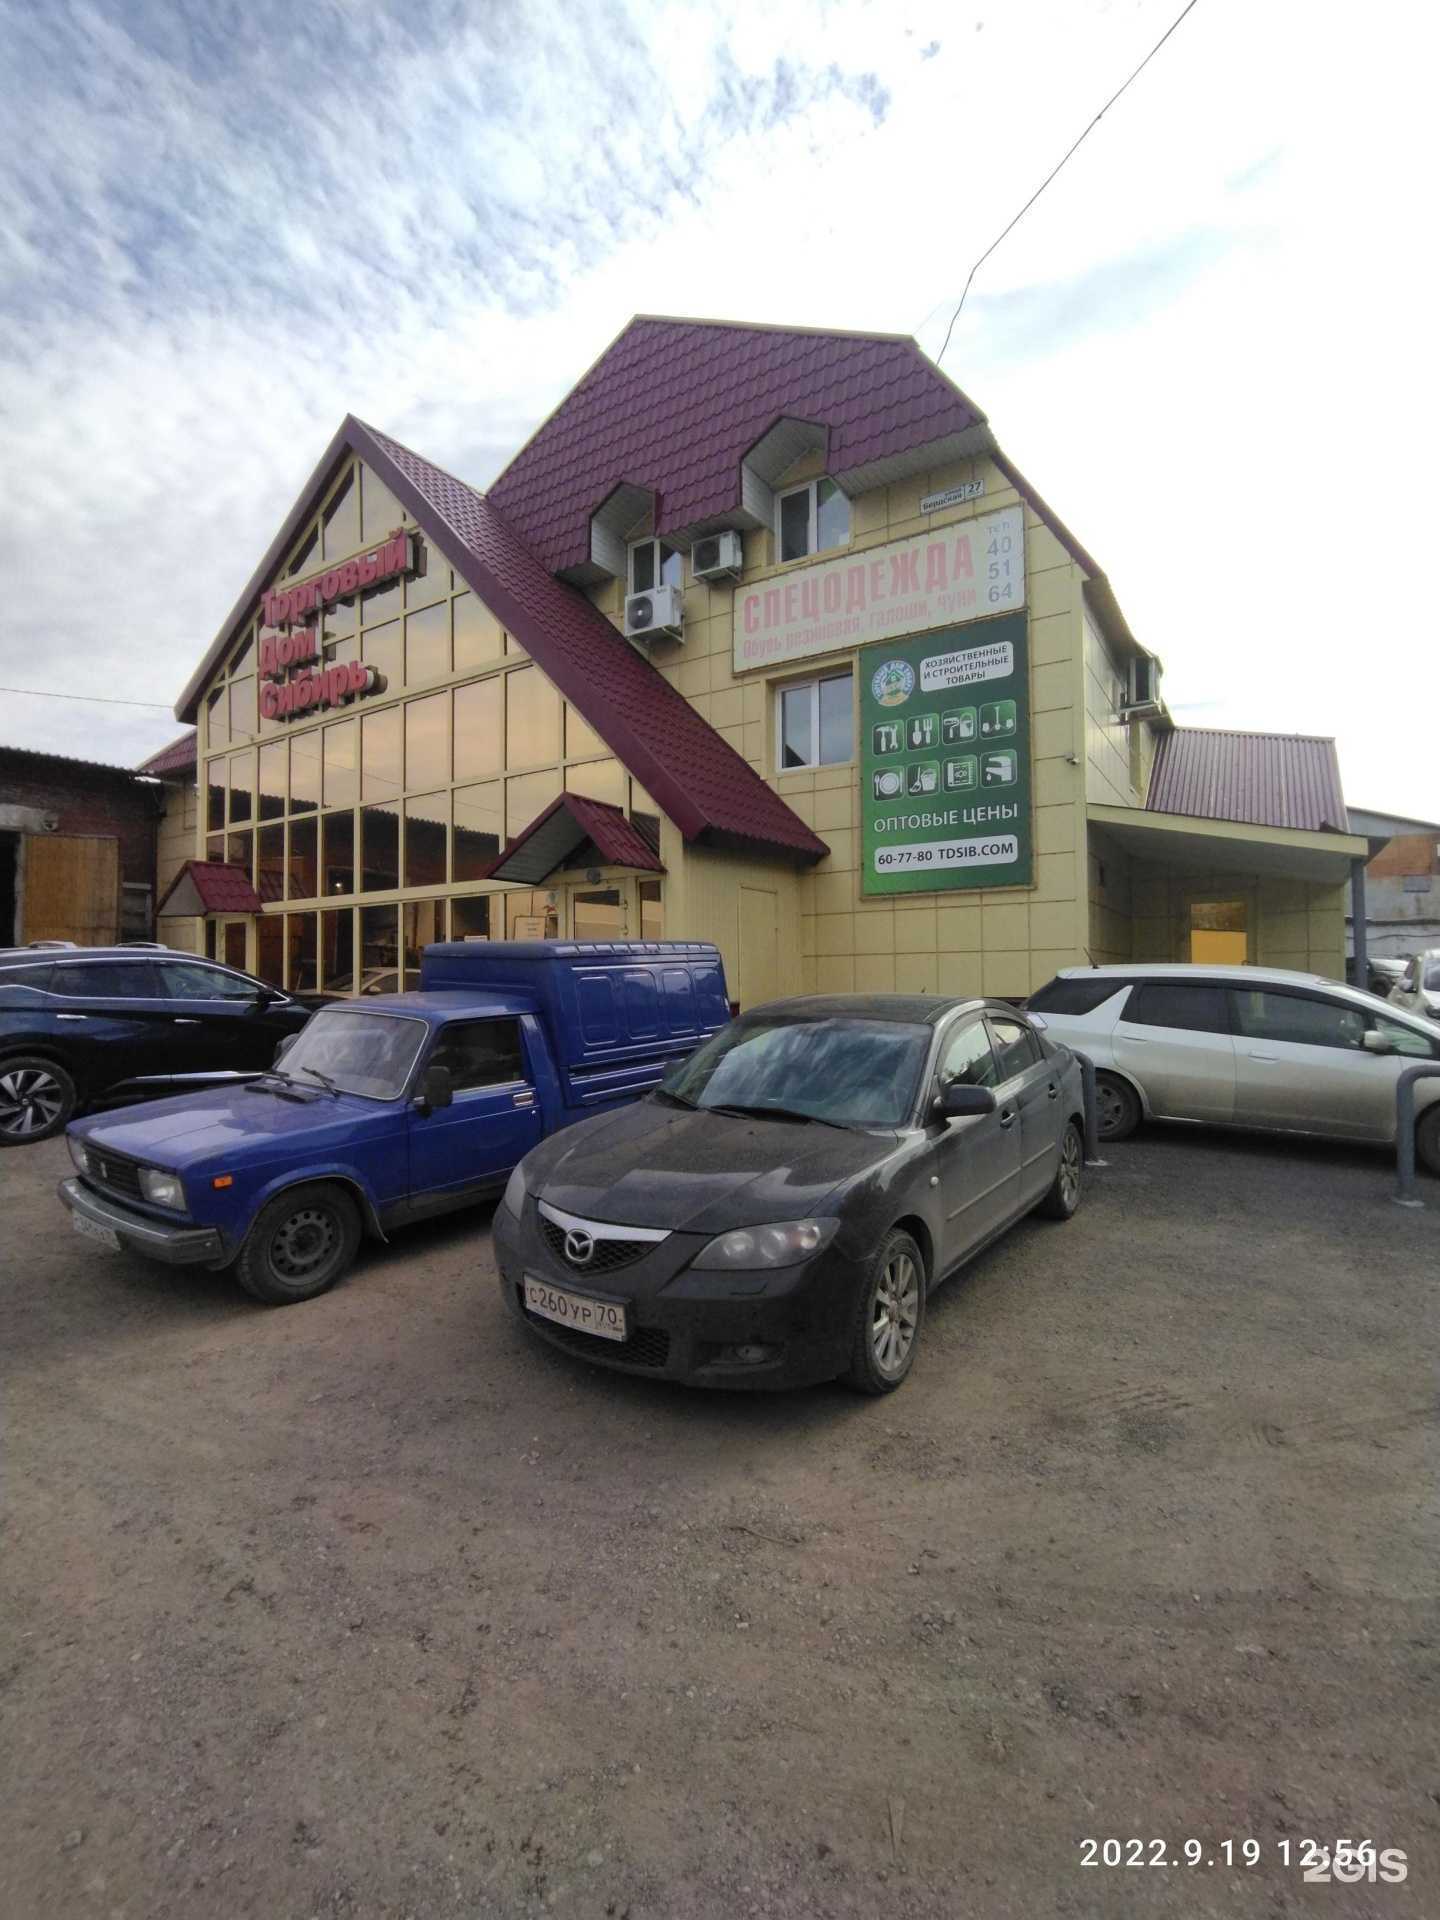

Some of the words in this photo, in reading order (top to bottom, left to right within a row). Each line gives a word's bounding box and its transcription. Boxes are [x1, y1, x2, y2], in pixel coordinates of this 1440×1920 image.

[968, 481, 981, 493] 27
[987, 536, 1012, 556] 40
[988, 559, 1011, 579] 51
[744, 535, 974, 635] СПЕЦОДЕЖДА
[988, 582, 1012, 602] 64
[924, 671, 931, 679] И
[932, 656, 1009, 677] СТРОИТЕЛЬНЫЕ
[925, 645, 1007, 669] ХОЗЯЙСТВЕННЫЕ
[261, 660, 368, 720] Сибирь
[946, 672, 985, 685] ТОВАРЫ
[874, 810, 958, 833] ОПТОВЫЕ
[962, 803, 1018, 825] ЦЕНЫ
[878, 851, 933, 865] 60-77-80
[938, 842, 1014, 860] TDSIB.COM
